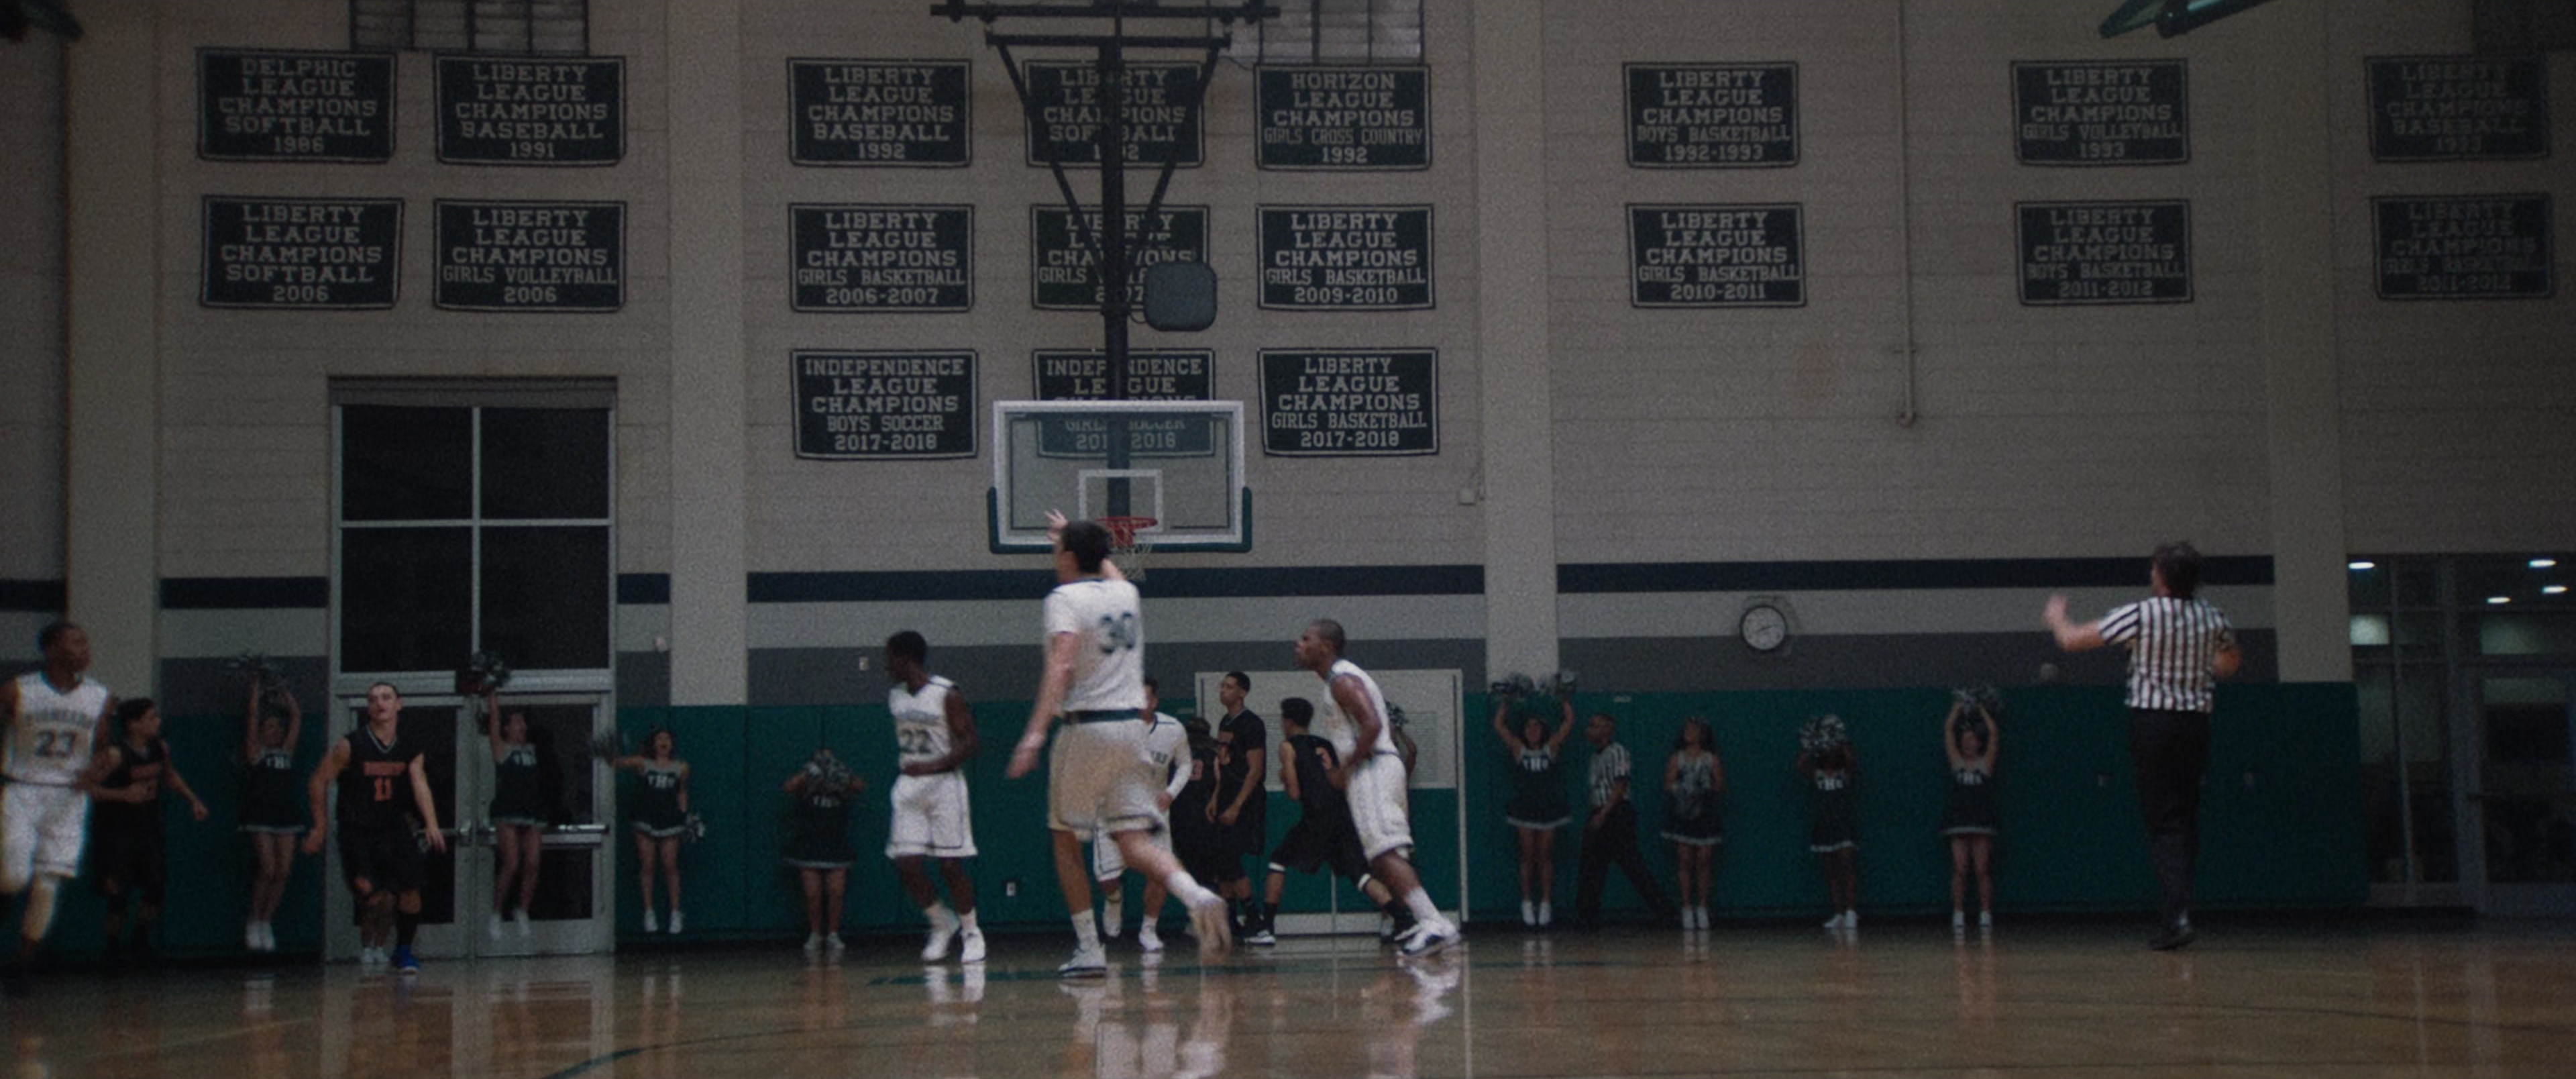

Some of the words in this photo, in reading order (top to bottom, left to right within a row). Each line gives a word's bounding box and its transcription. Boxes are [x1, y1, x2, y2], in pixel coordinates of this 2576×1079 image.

[242, 58, 356, 76] DELPHIC
[474, 64, 587, 82] LIBERTY
[825, 67, 934, 84] LIBERTY
[1061, 68, 1168, 86] LIBRTY
[1292, 73, 1395, 89] HORIZON
[1660, 70, 1764, 87] LIBERTY
[2047, 68, 2151, 85] LIBERTY
[243, 79, 354, 96] LEAGUE
[478, 84, 586, 101] LEAGUE
[830, 86, 932, 103] LEAGUE
[1064, 87, 1165, 105] LEGUE
[2051, 87, 2149, 103] LEAGUE
[2405, 83, 2508, 99] LEAGUE
[1295, 91, 1393, 108] LEAGUE
[1663, 89, 1762, 105] LEAGUE
[219, 98, 377, 118] CHAMPIONS
[456, 103, 607, 119] CHAMPIONS
[808, 105, 953, 121] CHAMPIONS
[1643, 108, 1782, 124] CHAMPIONS
[2031, 105, 2171, 121] CHAMPIONS
[2386, 100, 2530, 117] CHAMPIONS
[226, 115, 370, 137] SOFTBALL
[1274, 110, 1413, 126] CHAMPIONS
[462, 122, 603, 139] BASEBALL
[814, 123, 949, 141] BASEBALL
[1264, 127, 1303, 144] GIRLS
[1311, 127, 1354, 145] CROSS
[1361, 128, 1422, 144] COUNTRY
[1637, 125, 1678, 142] BOYS
[1689, 126, 1790, 142] BASKETBALL
[2023, 123, 2068, 140] GIRLS
[2079, 121, 2181, 140] VOLLEYBALL
[511, 142, 554, 158] 1991
[859, 143, 904, 159] 1992
[1323, 147, 1367, 163] 1992
[1666, 144, 1763, 161] 1992-1993
[2080, 142, 2125, 158] 1993
[244, 205, 364, 223] LIBERTY
[474, 209, 588, 226] LIBERTY
[826, 212, 936, 229] LIBERTY
[1291, 213, 1397, 229] LIBERTY
[1662, 212, 1767, 229] LIBERTY
[2051, 209, 2153, 225] LIBERTY
[246, 225, 360, 243] LEAGUE
[476, 229, 586, 246] LEAGUE
[1666, 229, 1765, 246] LEAGUE
[2055, 227, 2153, 244] LEAGUE
[2411, 221, 2513, 238] LEAGUE
[830, 232, 936, 248] LEAGUE
[1295, 232, 1396, 248] LEAGUE
[2392, 239, 2534, 255] CHAMPIONS
[222, 246, 382, 263] CHAMPIONS
[453, 248, 606, 265] CHAMPIONS
[808, 250, 956, 266] CHAMPIONS
[1276, 250, 1417, 266] CHAMPIONS
[1646, 248, 1786, 264] CHAMPIONS
[2034, 244, 2174, 260] CHAMPIONS
[227, 264, 373, 282] SOFTBALL
[443, 266, 494, 283] GIRLS
[505, 268, 617, 284] VOLLEYBALL
[798, 268, 847, 285] GIRLS
[861, 269, 965, 285] BASKETBALL
[1038, 266, 1087, 283] GIRLS
[1266, 268, 1311, 285] GIRLS
[1326, 269, 1426, 285] BASKETBALL
[1639, 266, 1684, 282] GIRLS
[1698, 266, 1800, 282] BASKETBALL
[2027, 263, 2068, 279] BOYS
[2080, 262, 2183, 278] BASKETBALL
[274, 285, 328, 302] 2006
[504, 287, 557, 303] 2006
[826, 288, 938, 304] 2006-2007
[1295, 287, 1397, 303] 2009-2010
[1671, 284, 1765, 299] 2010-2011
[2059, 280, 2152, 297] 2011-2012
[806, 359, 963, 375] INDEPENDENCE
[1046, 358, 1202, 376] INDEPNDENCE
[1305, 358, 1391, 374] LIBERTY
[834, 378, 936, 395] LEAGUE
[1074, 377, 1177, 394] LEGUE
[1299, 376, 1399, 392] LEAGUE
[812, 396, 957, 413] CHAMPIONS
[1279, 395, 1419, 410] CHAMPIONS
[828, 415, 870, 431] BOYS
[881, 415, 943, 431] SOCCER
[1272, 412, 1318, 429] GIRLS
[1328, 412, 1427, 428] BASKETBALL
[835, 434, 936, 450] 2017-2018
[1301, 431, 1399, 447] 2017-2018
[898, 728, 934, 756] 22
